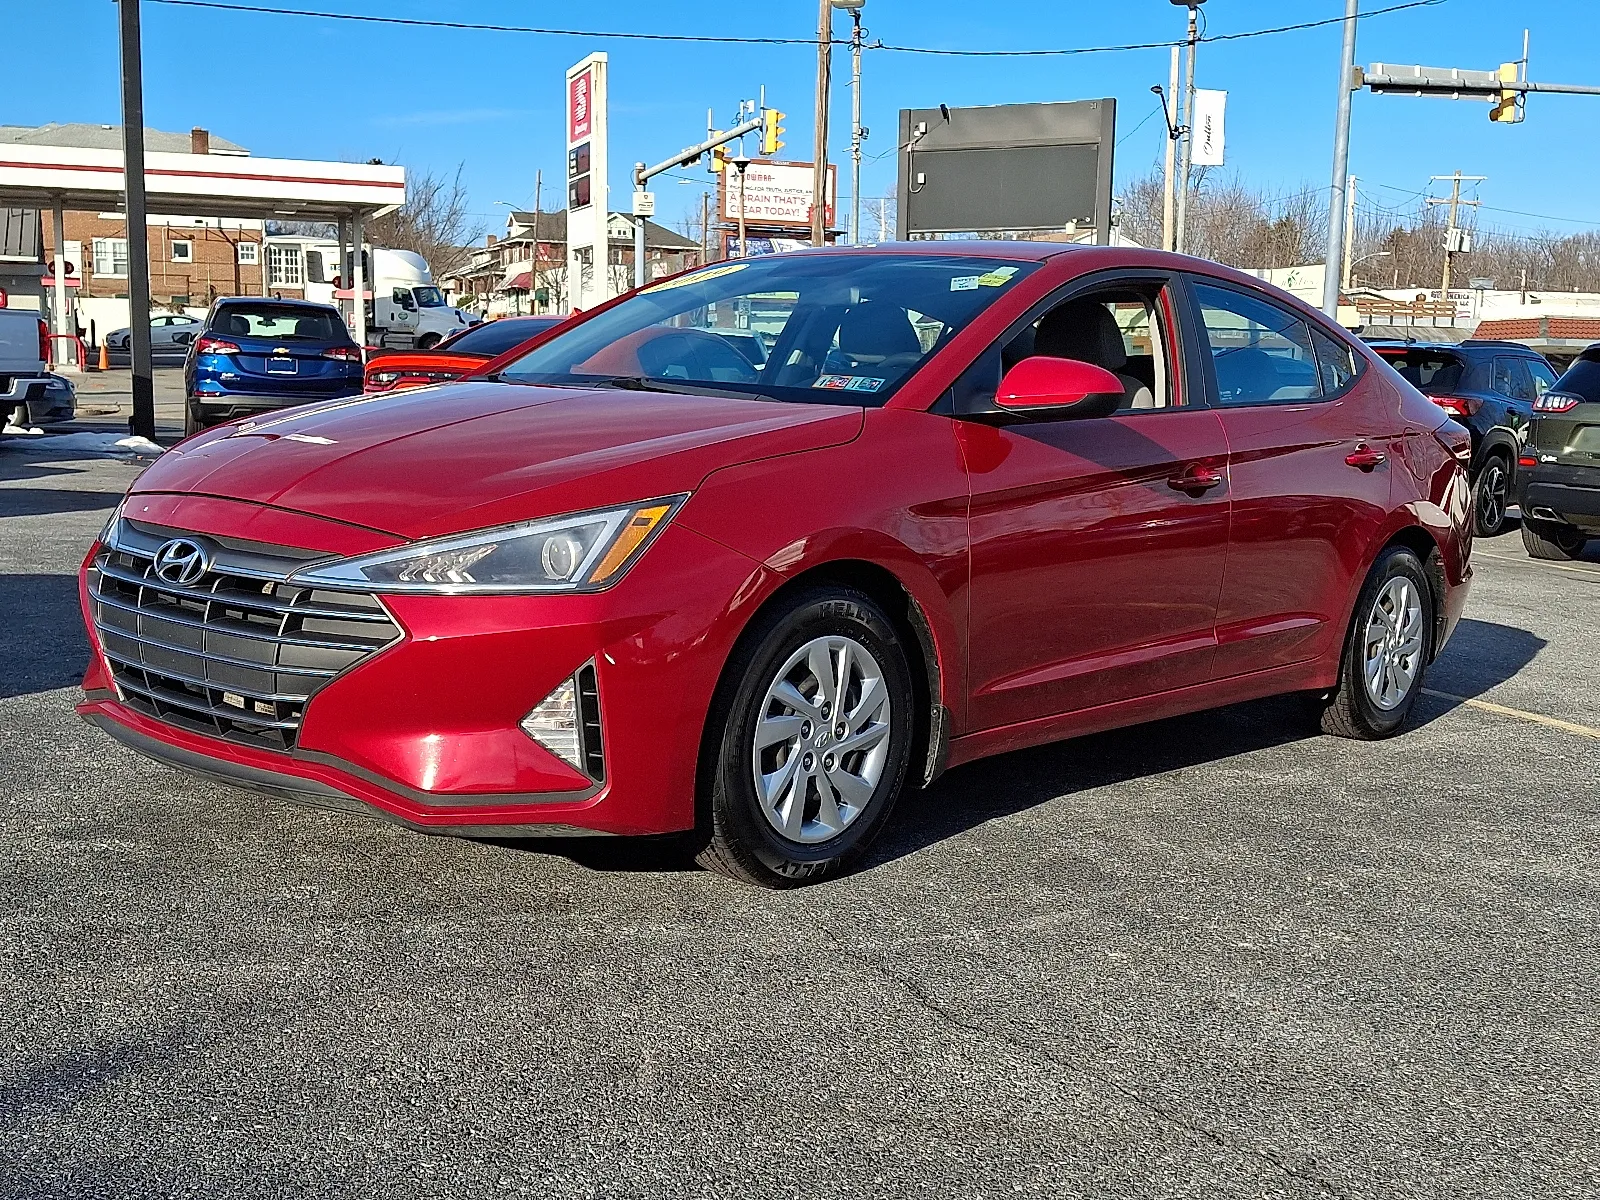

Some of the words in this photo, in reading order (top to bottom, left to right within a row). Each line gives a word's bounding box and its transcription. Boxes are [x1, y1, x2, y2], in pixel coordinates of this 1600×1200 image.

[730, 193, 737, 202] A
[773, 195, 806, 206] THAT'S
[764, 206, 800, 217] TODAY!
[818, 601, 875, 625] KELLY
